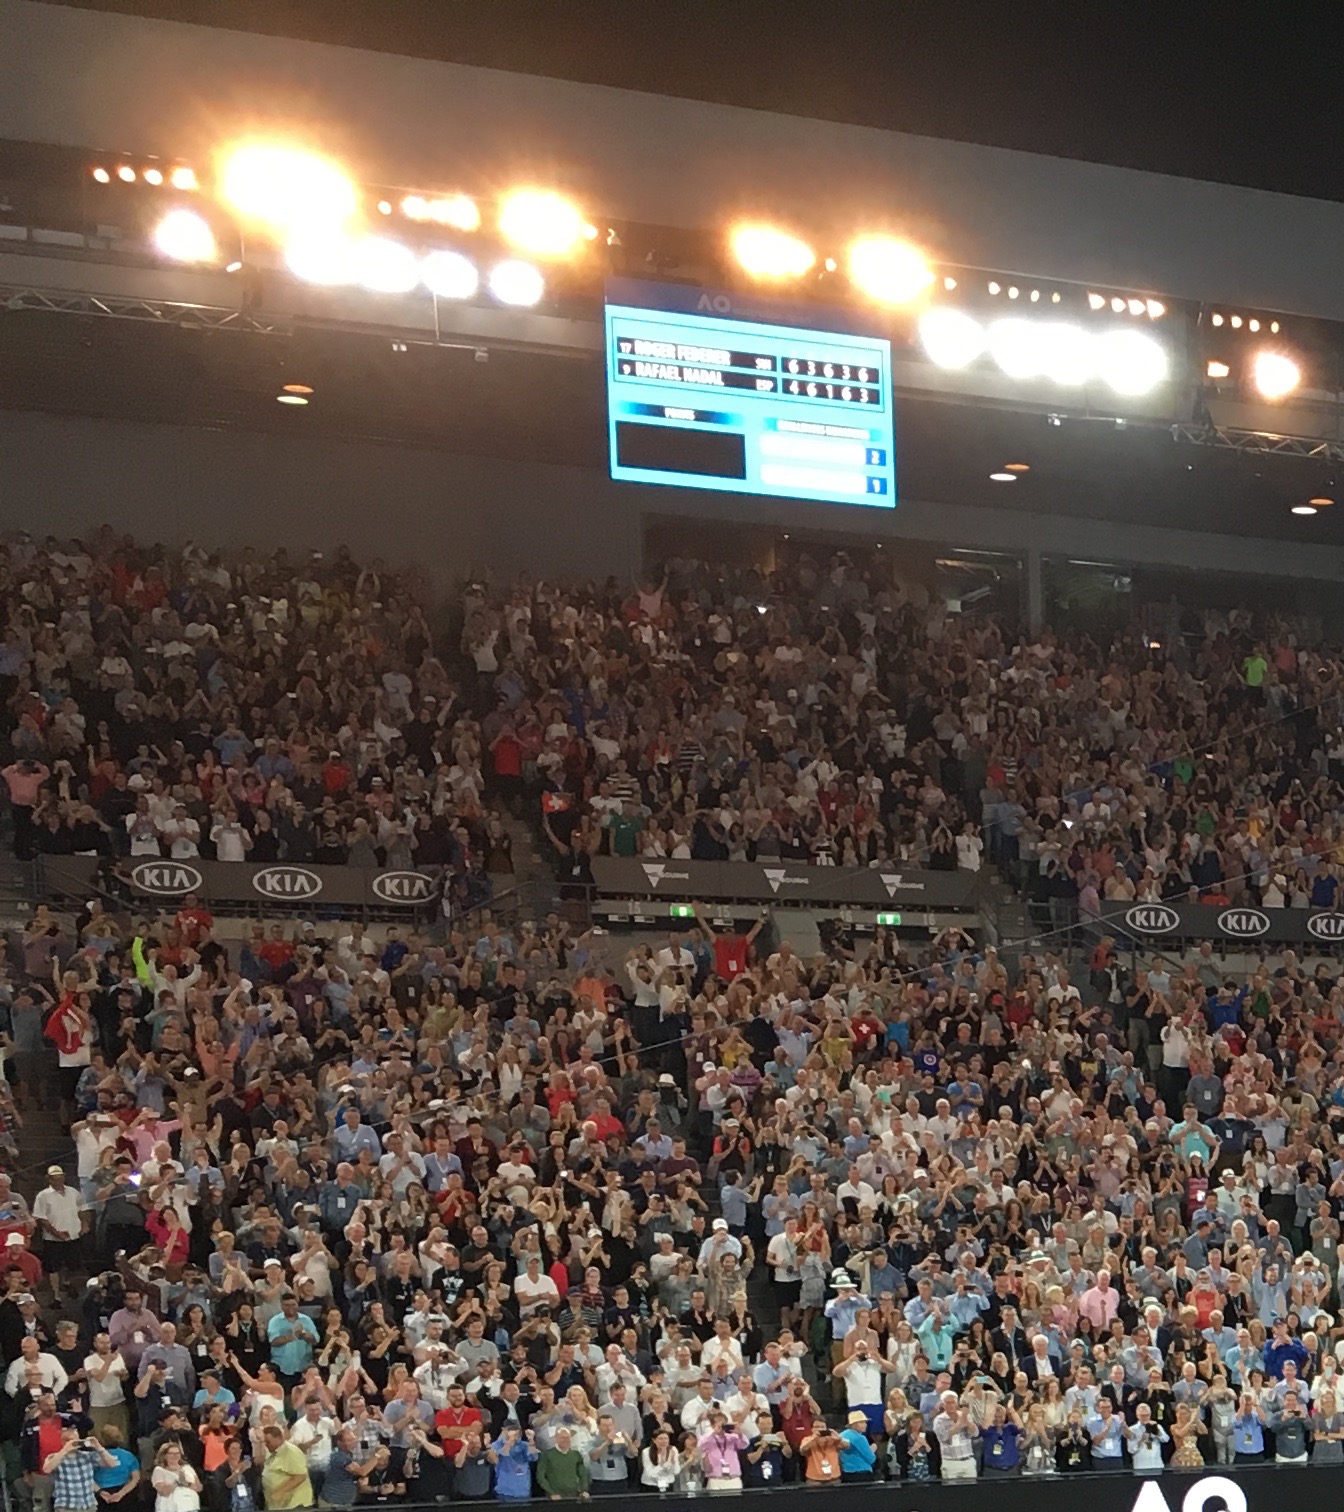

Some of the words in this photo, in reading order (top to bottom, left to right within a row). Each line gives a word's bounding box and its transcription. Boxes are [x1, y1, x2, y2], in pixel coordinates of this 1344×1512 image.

[789, 359, 799, 374] 6
[807, 360, 816, 376] 3
[823, 363, 834, 378] 6
[842, 365, 851, 380] 3
[858, 368, 869, 382] 6
[635, 362, 682, 381] RAFAEL
[683, 367, 724, 386] NADAL
[789, 380, 799, 395] 4
[807, 382, 817, 397] 6
[826, 384, 834, 399] 1
[841, 386, 852, 401] 6
[860, 388, 869, 403] 3
[143, 868, 191, 888] KIA
[264, 872, 309, 893] KIA
[385, 877, 430, 898] KIA
[1135, 912, 1170, 926] KIA
[1226, 916, 1261, 931] KIA
